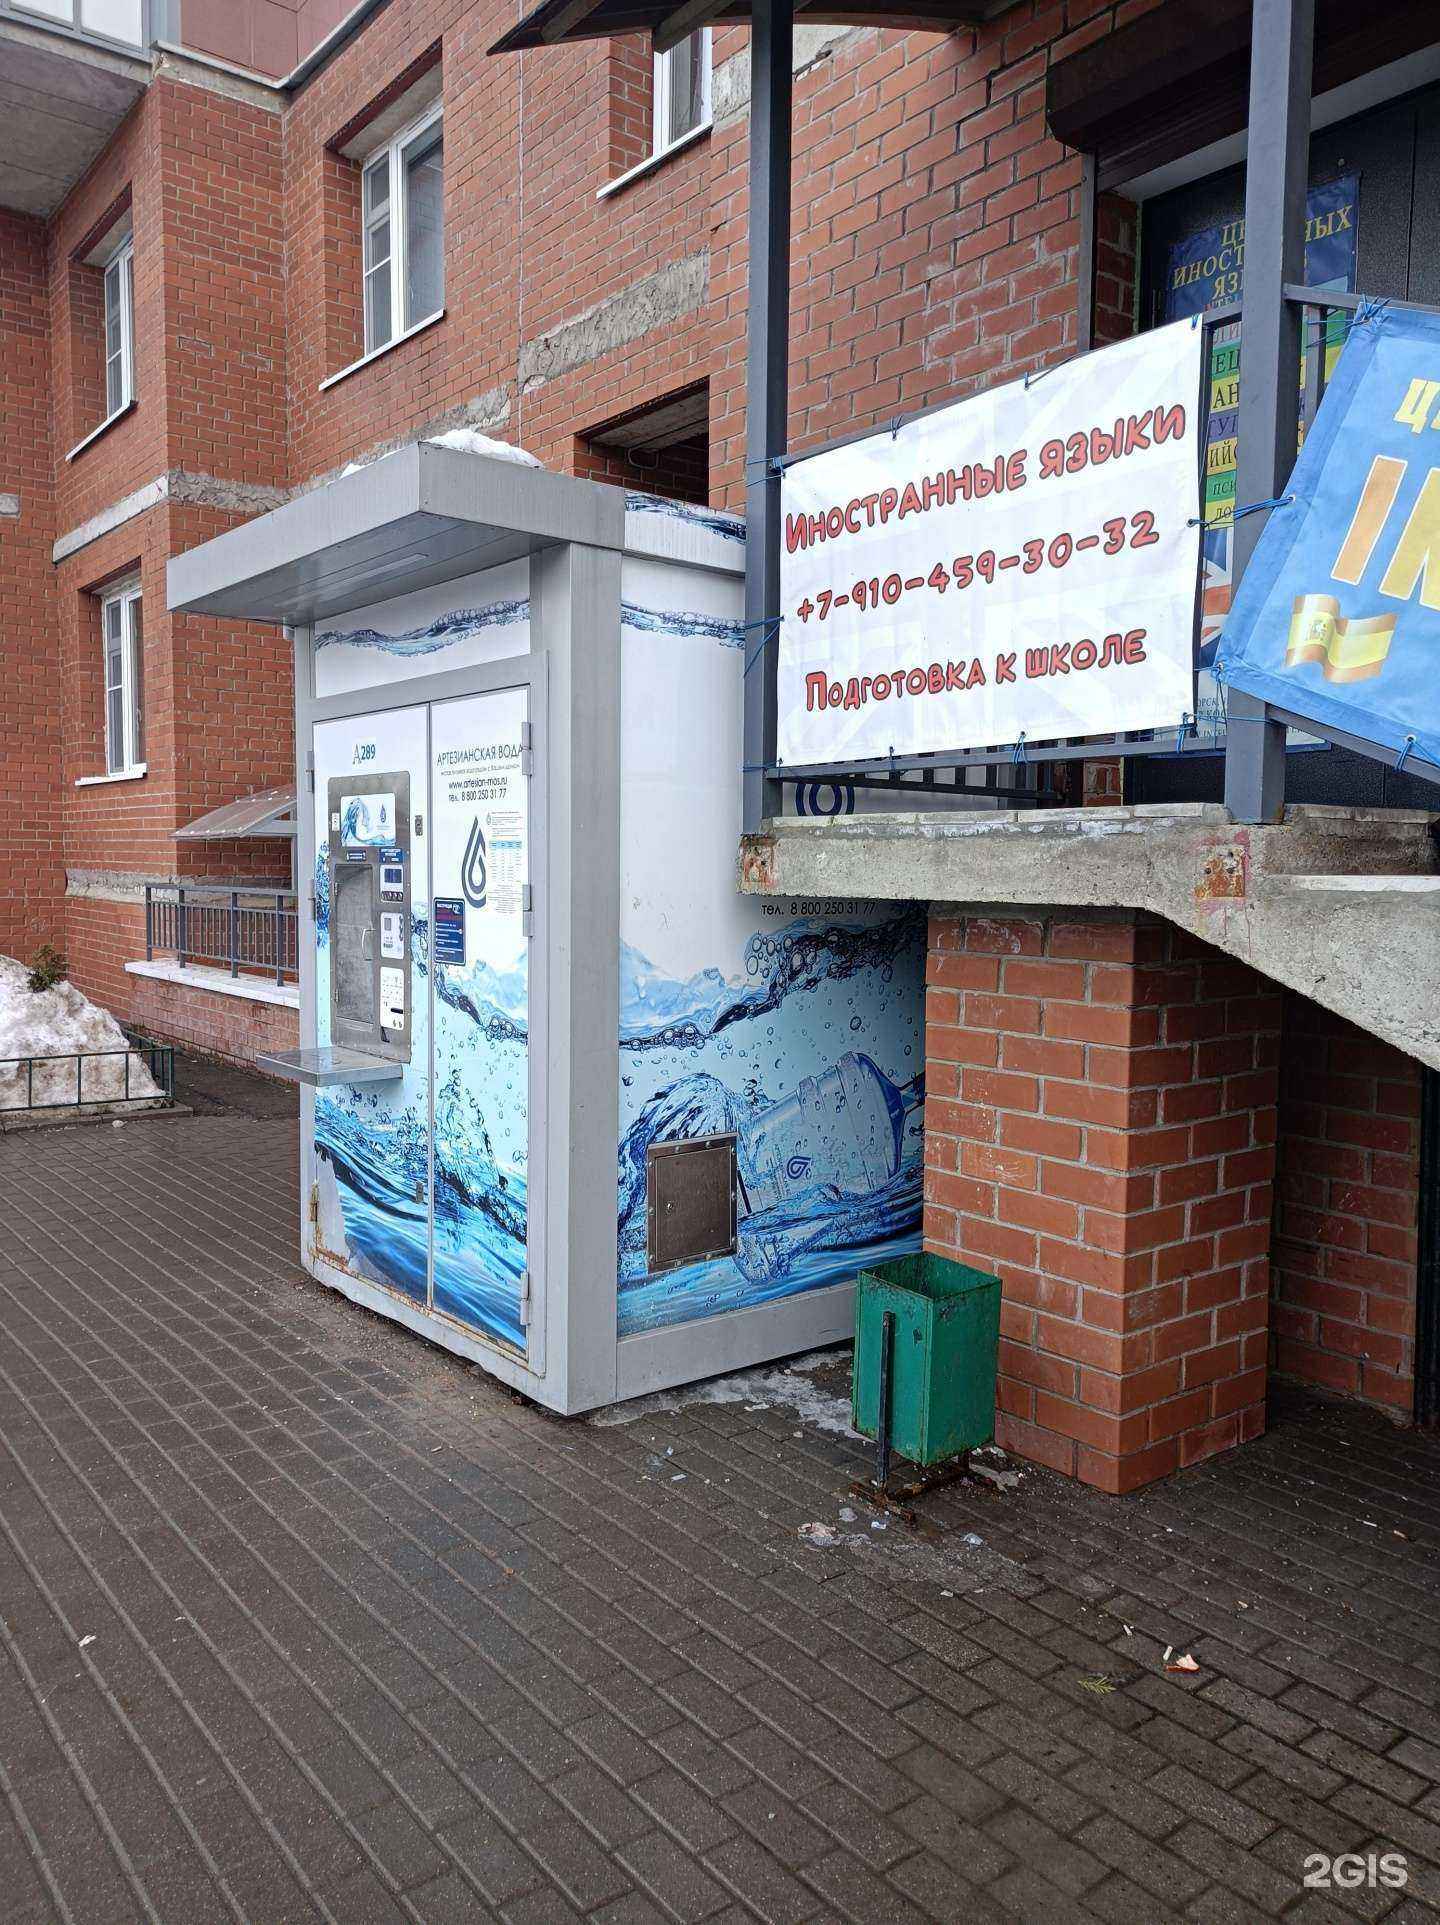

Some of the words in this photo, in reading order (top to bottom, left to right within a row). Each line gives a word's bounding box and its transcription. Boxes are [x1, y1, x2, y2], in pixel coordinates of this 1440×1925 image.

[785, 448, 1028, 554] ИНОСТРАННЫЕ
[1038, 404, 1186, 480] ЯЗЫКИ
[797, 510, 1160, 623] +7-910-459-30-32
[437, 746, 496, 766] АРТЕЗИАНСКАЯ
[498, 743, 523, 759] ВОДА
[466, 790, 477, 801] 800
[478, 789, 489, 800] 250
[490, 788, 497, 799] 31
[499, 787, 507, 798] 77
[761, 904, 784, 915] тел.
[790, 902, 798, 915] 8
[800, 902, 821, 915] 800
[824, 902, 844, 915] 250
[847, 902, 859, 914] 31
[863, 901, 876, 915] 77
